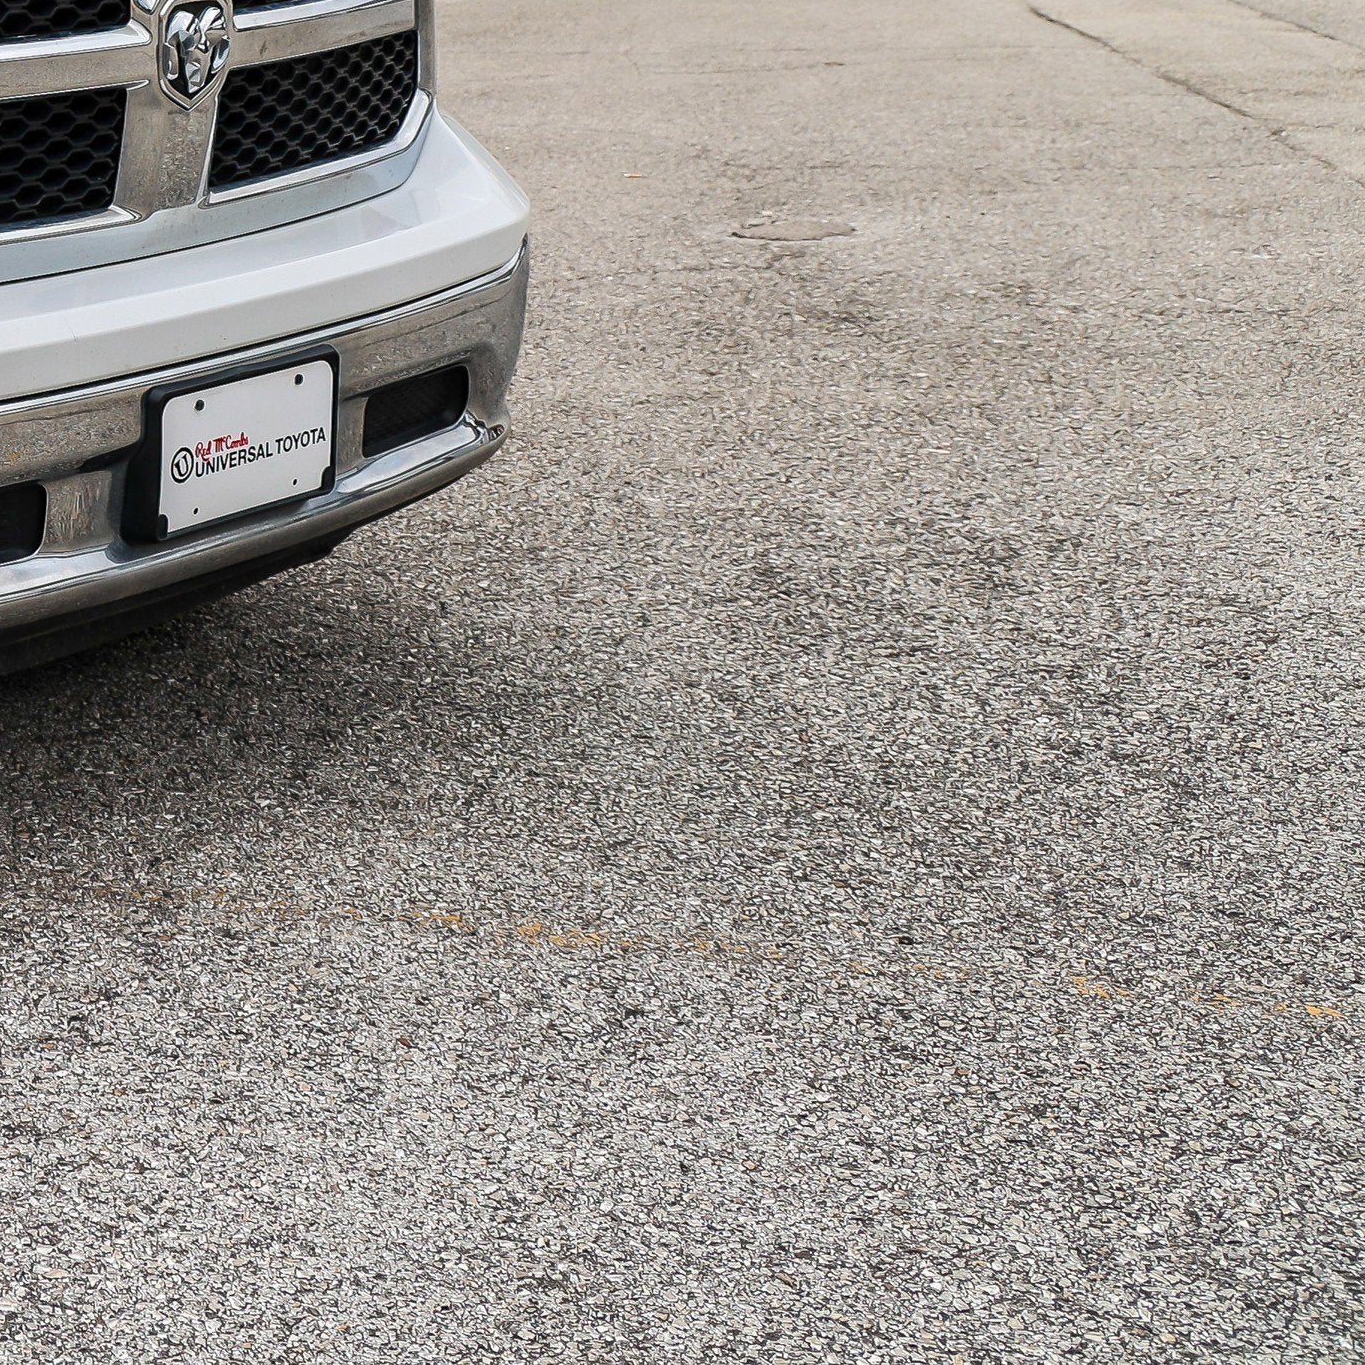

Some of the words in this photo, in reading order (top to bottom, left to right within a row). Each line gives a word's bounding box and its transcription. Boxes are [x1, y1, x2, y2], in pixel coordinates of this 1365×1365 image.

[194, 440, 212, 462] Red
[195, 442, 274, 478] UNIVERSAL
[275, 426, 327, 455] TOYOTA
